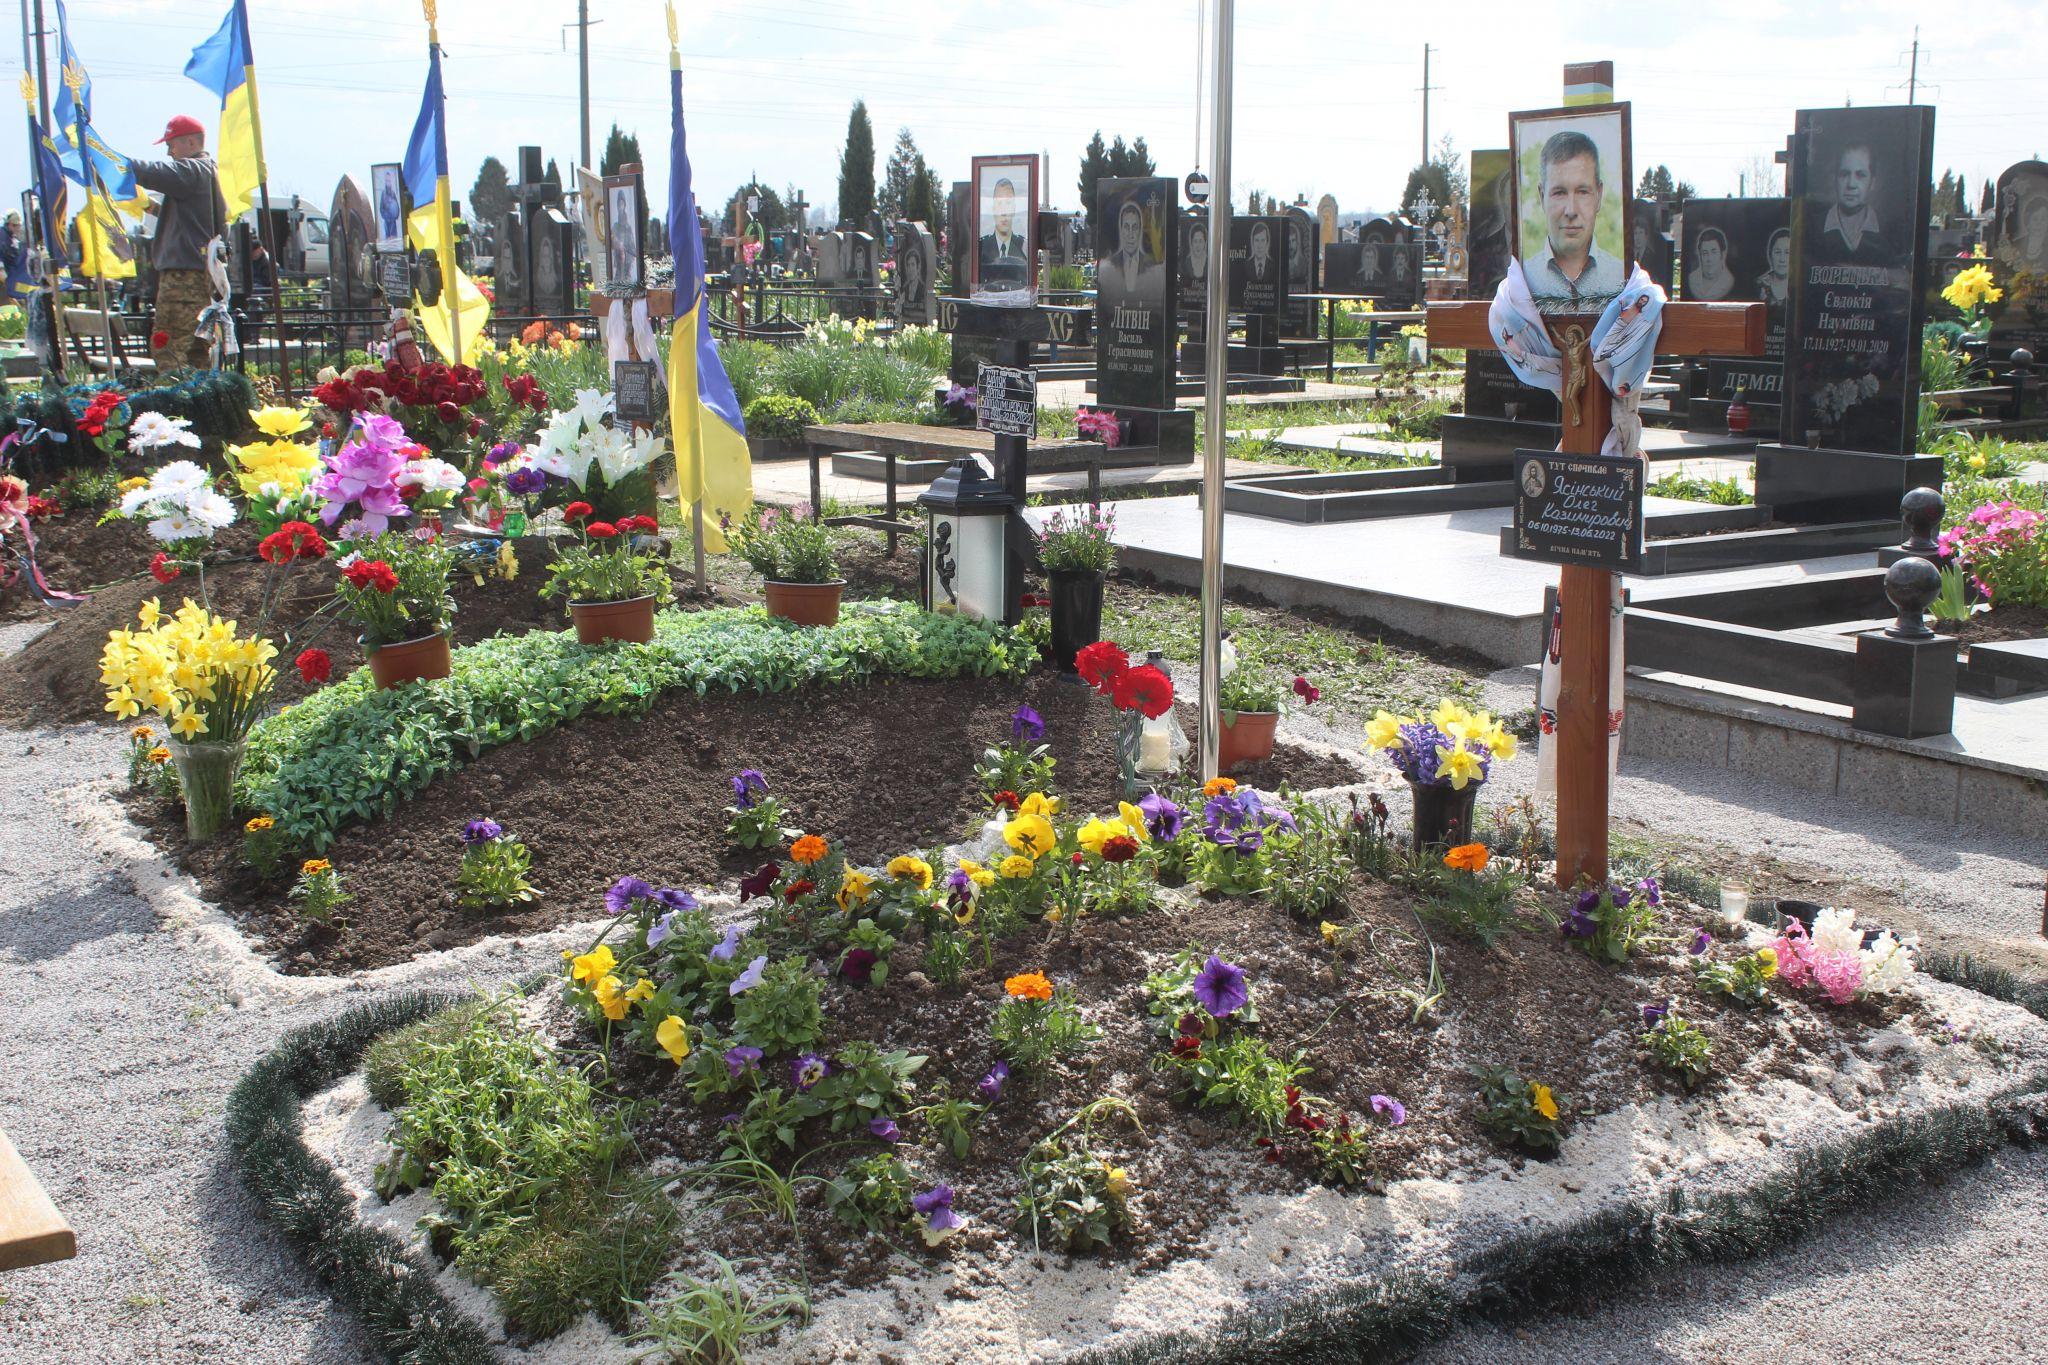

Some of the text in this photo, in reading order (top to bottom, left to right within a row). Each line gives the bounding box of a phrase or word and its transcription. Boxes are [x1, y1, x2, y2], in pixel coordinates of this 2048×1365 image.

[1808, 265, 1889, 289] БОРЕЦЬКА
[1824, 290, 1872, 309] Євдокія
[1110, 300, 1151, 330] Літвін
[1819, 312, 1875, 334] Наумівна
[1118, 330, 1143, 343] Василь
[1108, 343, 1154, 359] Герасимович
[1548, 461, 1607, 475] ТУТ СПОЧИВАЄ
[1553, 475, 1625, 501] Ясінський
[1563, 495, 1598, 512] Олег
[1542, 502, 1632, 530] Казимирович
[1550, 545, 1570, 553] ВІЧНА
